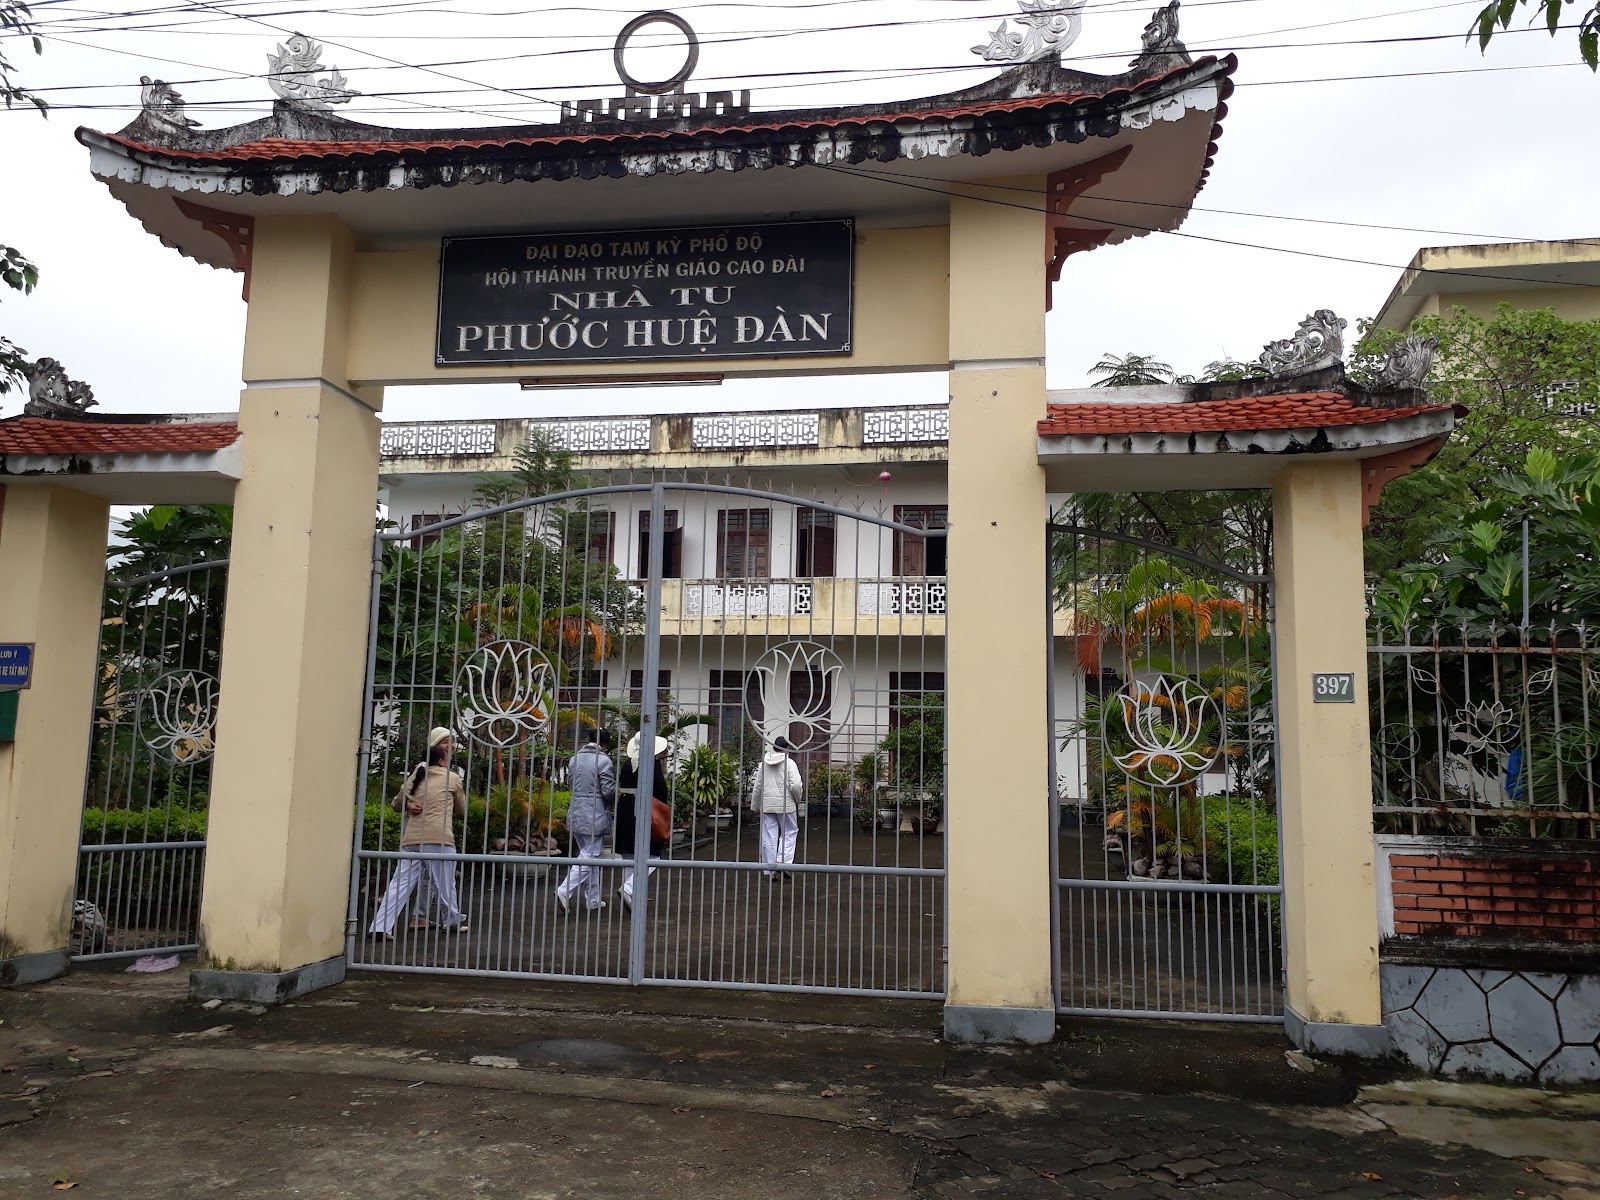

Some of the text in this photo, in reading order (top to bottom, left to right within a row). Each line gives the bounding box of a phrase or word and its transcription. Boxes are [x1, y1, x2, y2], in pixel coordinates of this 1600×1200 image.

[526, 230, 763, 263] ĐẠI ĐẠO TAM KỲ PHỔ ĐỘ
[485, 255, 805, 288] HỘI THÁNH TRUYỀN GIÁO CAO ĐÀI
[550, 284, 736, 311] NHÀ TU
[456, 305, 832, 353] PHƯỚC HUỆ ĐÀN
[1316, 676, 1350, 695] 397
